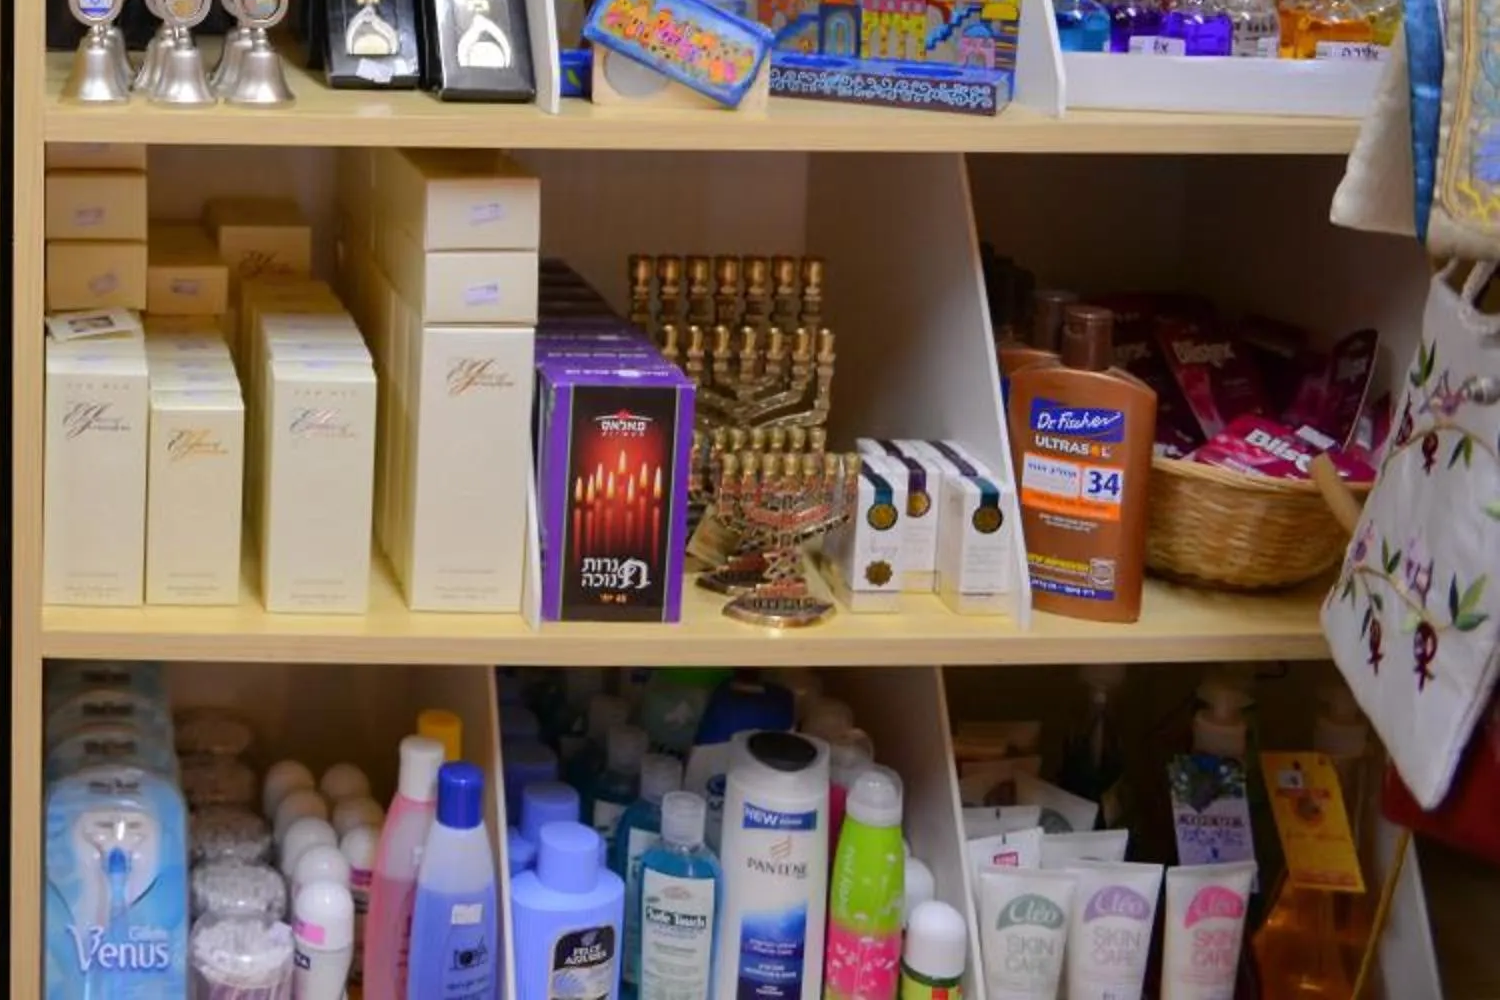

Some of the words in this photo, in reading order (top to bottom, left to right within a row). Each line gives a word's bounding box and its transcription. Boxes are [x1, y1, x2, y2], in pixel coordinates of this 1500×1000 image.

[1058, 410, 1121, 430] Fischer
[1088, 470, 1120, 496] 34
[581, 557, 619, 573] נרות
[745, 807, 779, 826] NEW
[746, 857, 808, 879] PANTENE
[66, 926, 170, 972] Venus
